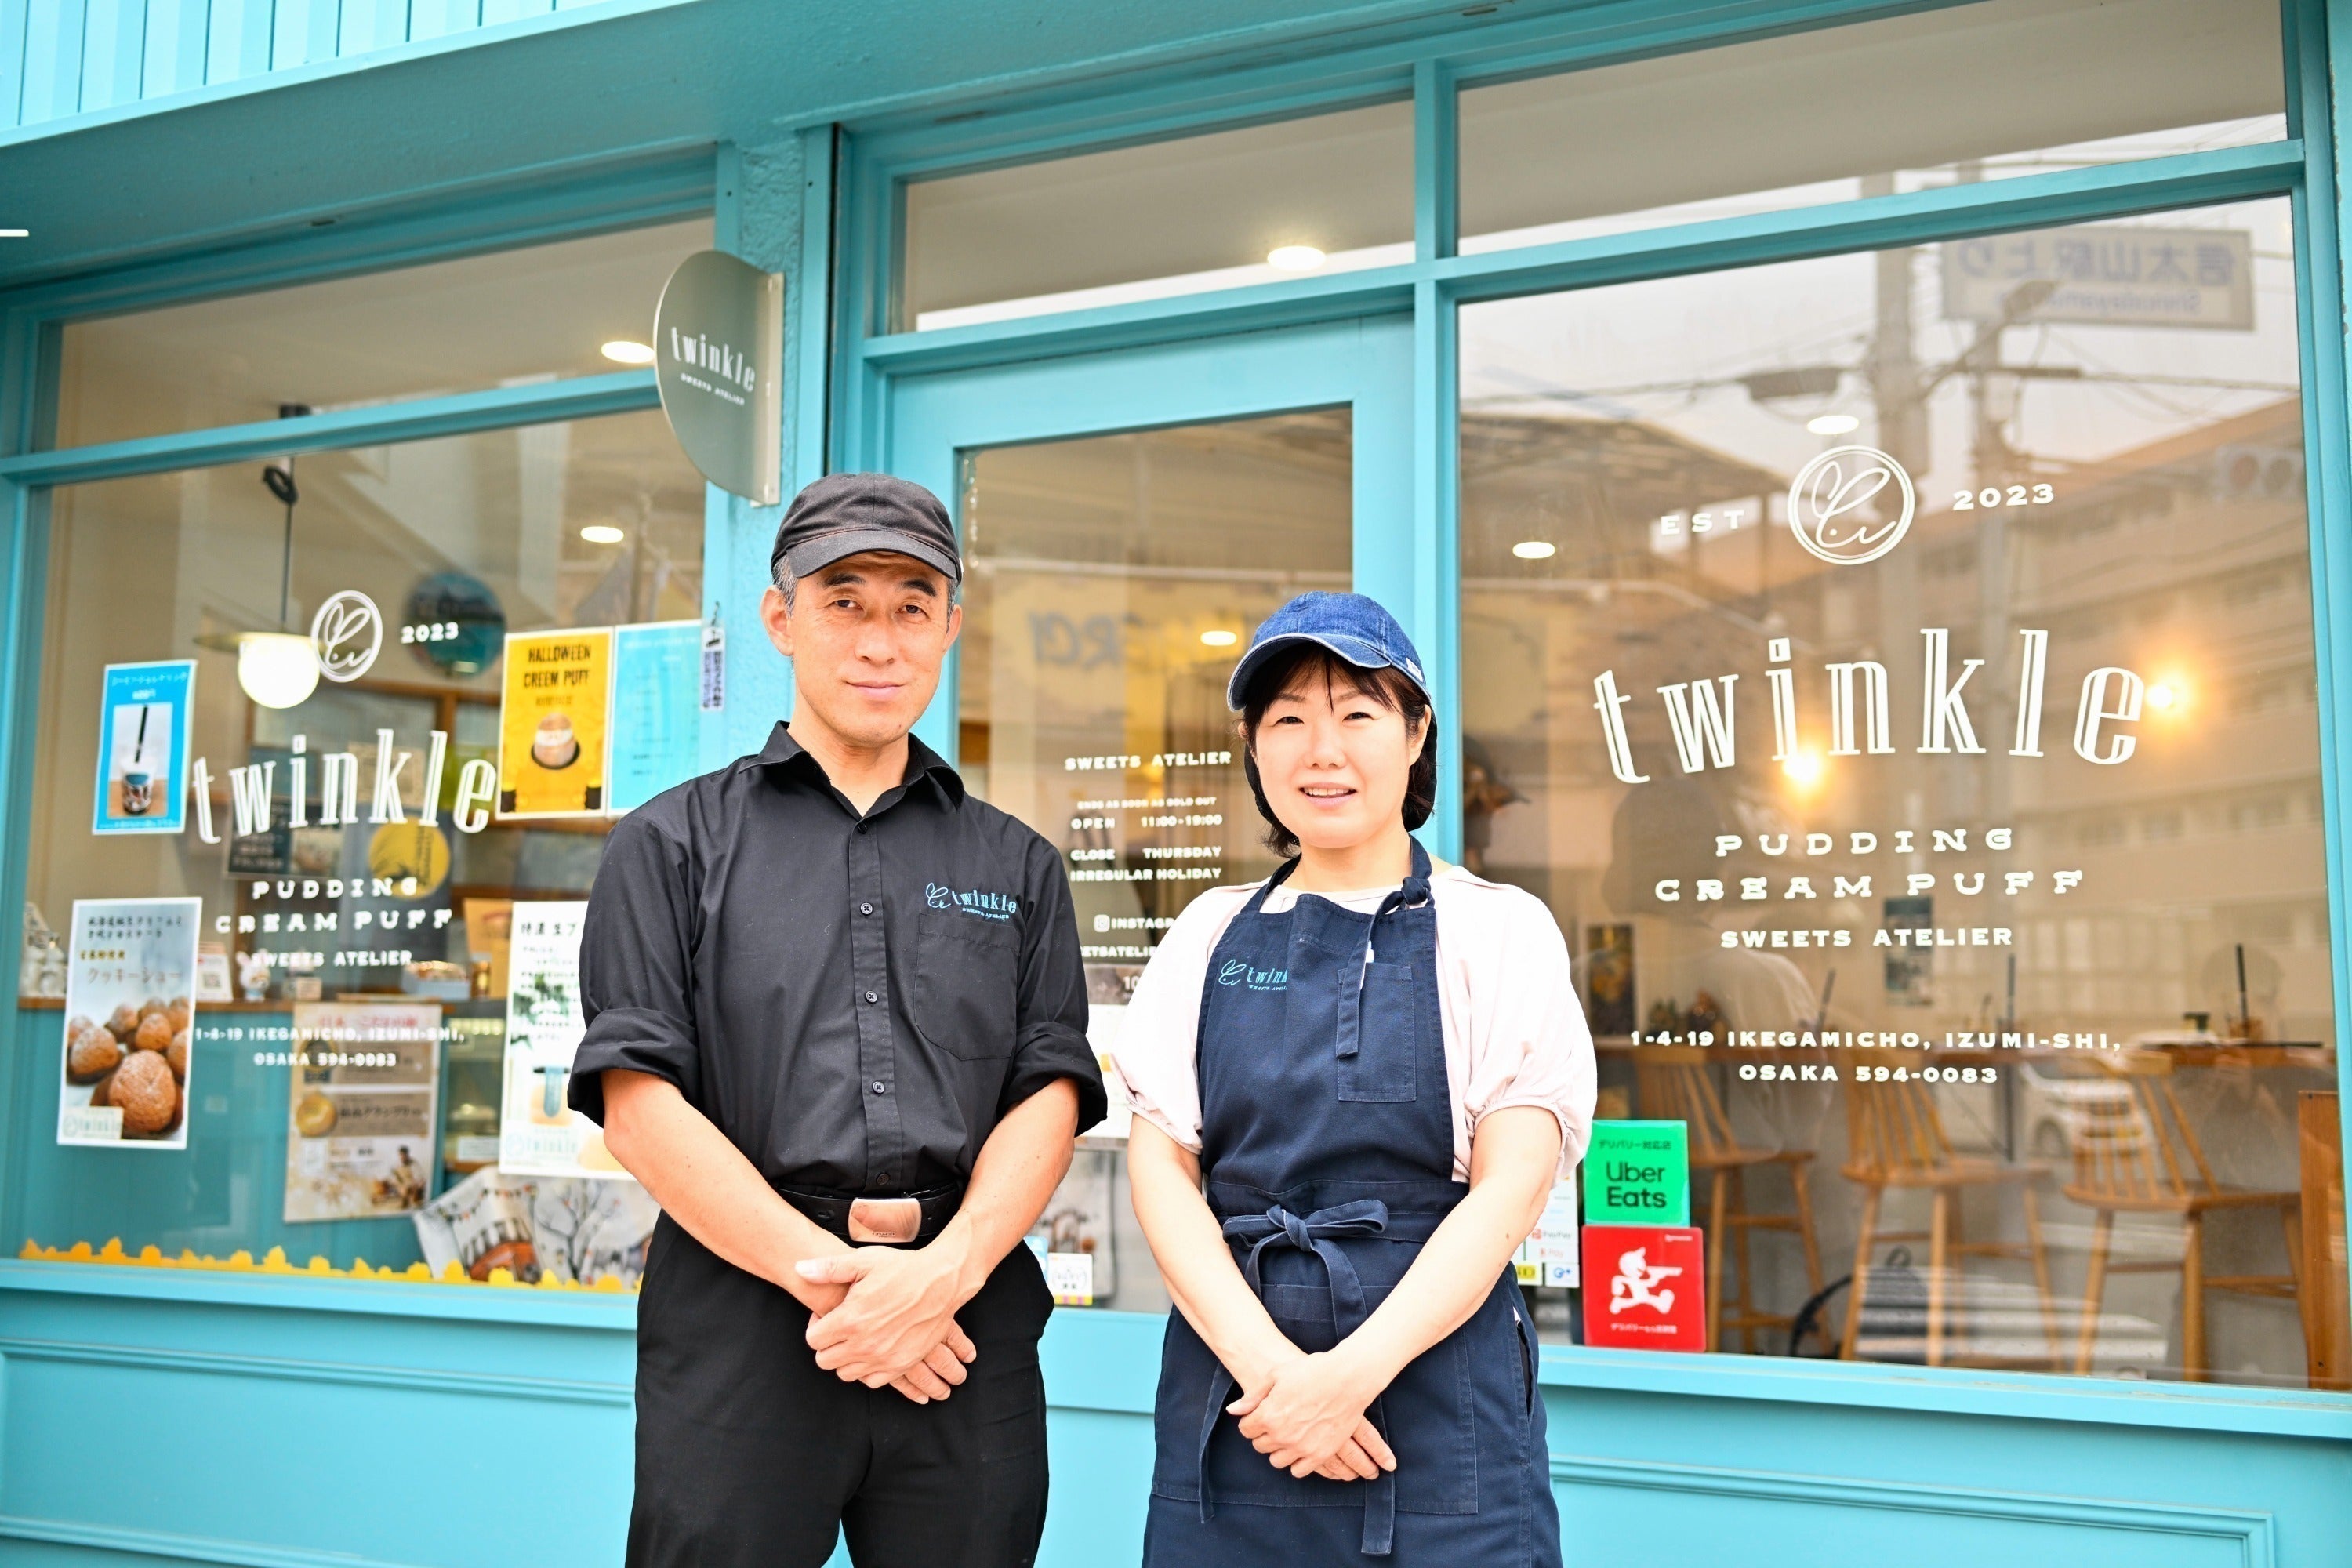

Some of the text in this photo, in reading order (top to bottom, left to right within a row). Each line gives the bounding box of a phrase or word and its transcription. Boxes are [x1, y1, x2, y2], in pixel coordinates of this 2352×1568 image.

[671, 326, 756, 392] twinkle
[1952, 484, 2054, 511] 2023
[1661, 510, 1744, 536] EST
[401, 622, 459, 644] 2023
[528, 644, 592, 663] HALLOWEEN
[564, 669, 590, 686] PUFF
[1593, 628, 2144, 784] twinkle
[1065, 751, 1232, 771] SWEETS ATELIER
[193, 728, 497, 844] twinkle
[1195, 797, 1217, 806] OUT
[1071, 817, 1116, 829] OPEN
[1715, 828, 2013, 857] PUDDING
[1070, 846, 1222, 861] CLOSE THURSDAY
[1070, 867, 1222, 882] IRREGULAR HOLIDAY
[252, 878, 419, 899] PUDDING
[1655, 870, 2085, 902] CREAM PUFF
[951, 889, 1018, 913] twinkle
[216, 909, 453, 934] CREAM PUFF
[1111, 916, 1174, 929] INSTAGR
[1720, 927, 2013, 949] SWEETS ATELIER
[252, 949, 412, 968] SWEETS ATELIER
[1247, 967, 1288, 983] twin
[195, 1027, 465, 1045] 1-4-19 IKEGAMICHO, IZUMI-SHI,
[1631, 1030, 2122, 1053] 1-4-19 IKEGAMICHO, IZUMI-SHI,
[253, 1052, 311, 1066] OSAKA
[318, 1052, 397, 1067] 594-0083
[1738, 1065, 1998, 1083] OSAKA 594-0083
[1598, 1139, 1672, 1150] デリバリー対応店
[1606, 1161, 1665, 1183] Uber
[1607, 1185, 1667, 1208] Eats
